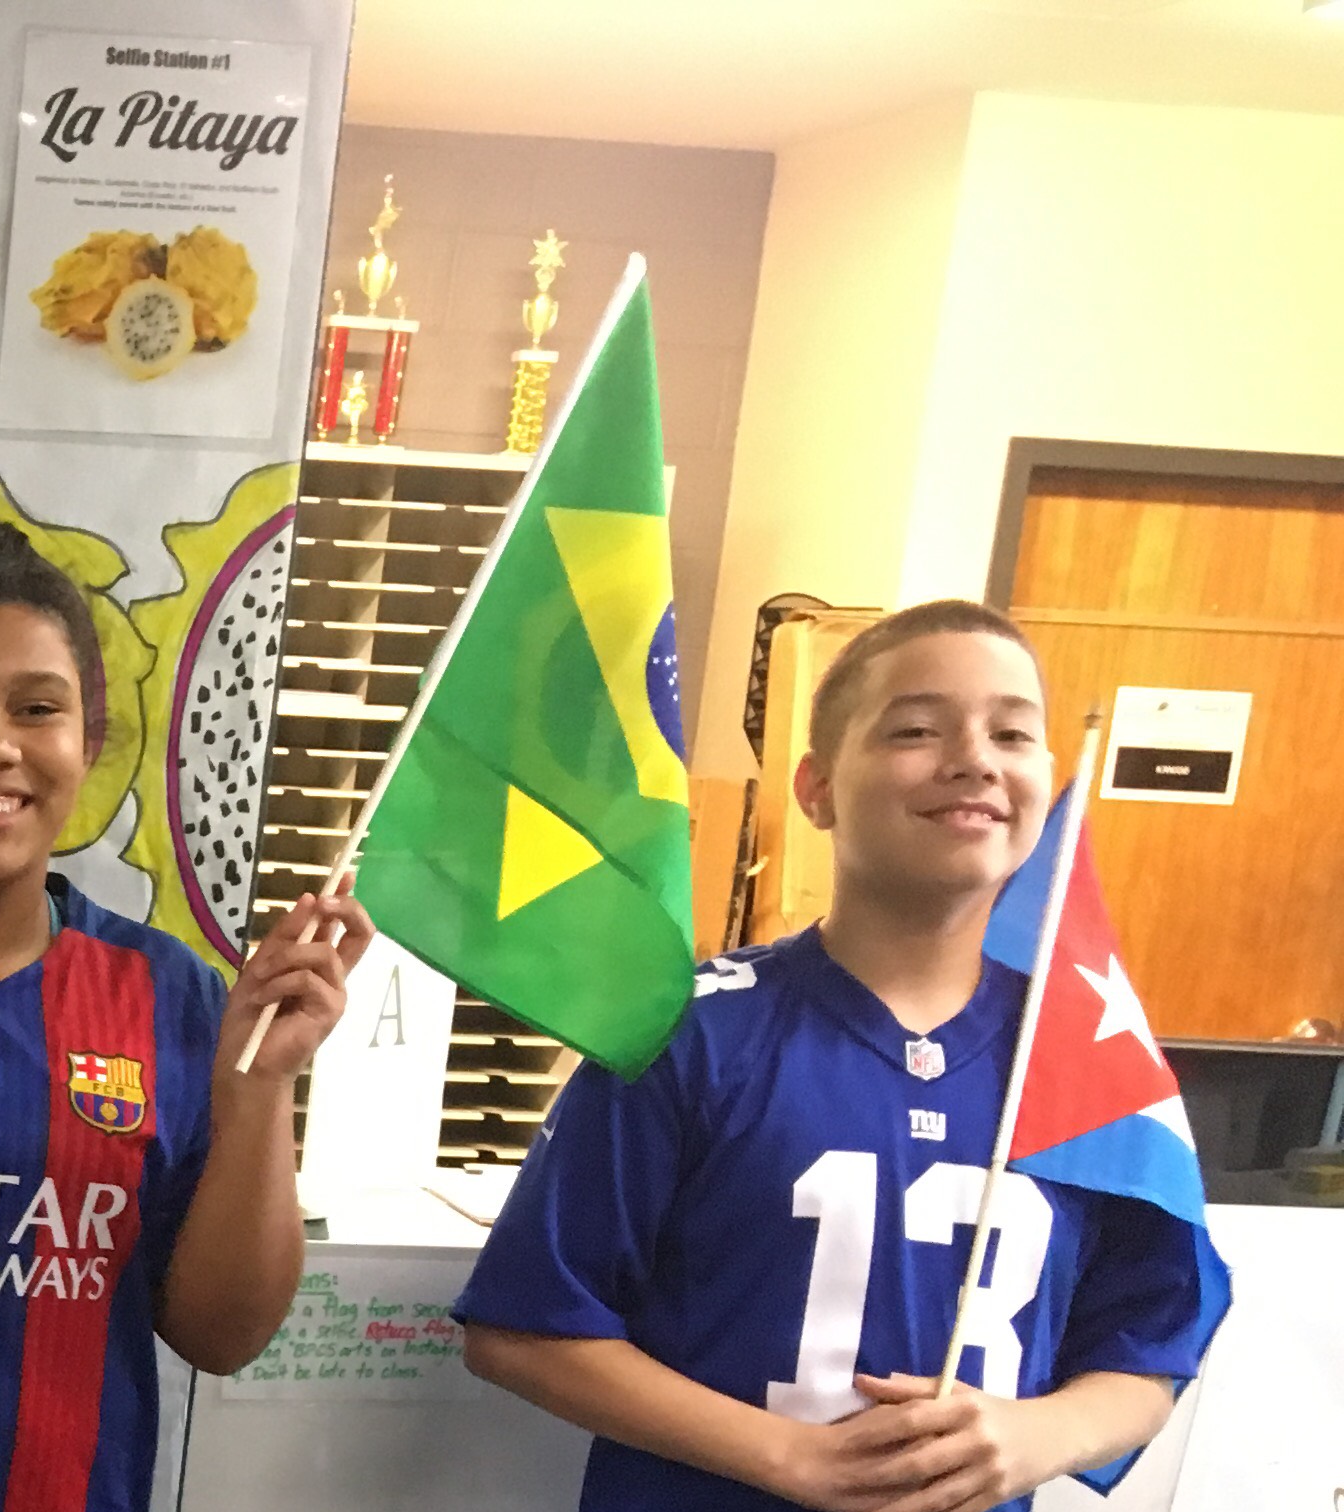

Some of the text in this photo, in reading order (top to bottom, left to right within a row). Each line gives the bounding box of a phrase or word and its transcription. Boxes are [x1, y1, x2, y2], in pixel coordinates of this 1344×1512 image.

[105, 46, 230, 70] Selfie Station #1
[40, 88, 300, 171] La Pitaya
[368, 964, 407, 1048] A
[92, 1082, 124, 1097] FCB
[767, 1150, 1054, 1424] 13
[322, 1295, 358, 1324] flag
[367, 1296, 404, 1317] from
[365, 1321, 416, 1340] Return
[295, 1362, 311, 1380] be
[318, 1361, 346, 1379] late
[356, 1361, 374, 1379] to
